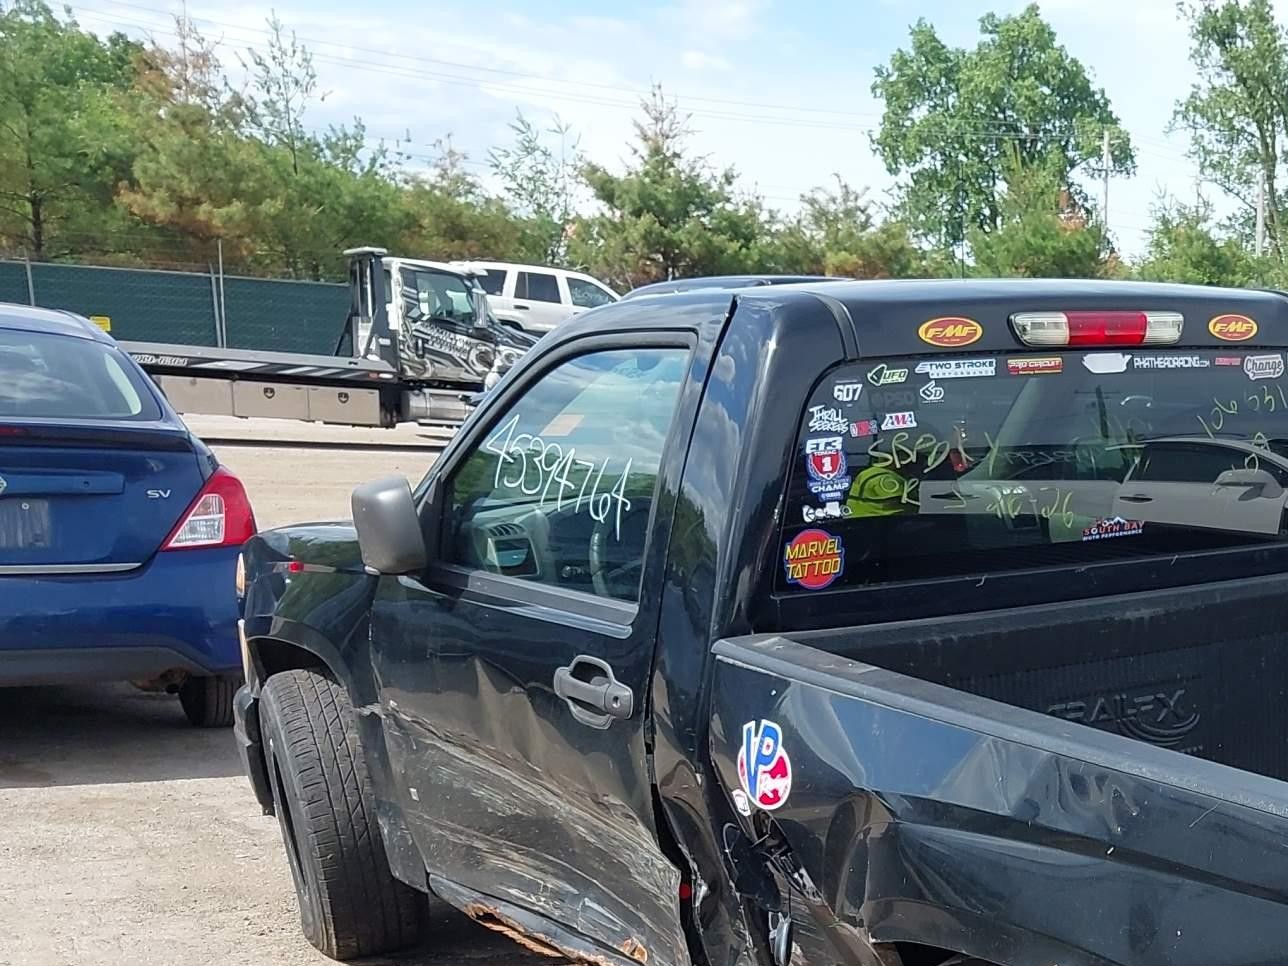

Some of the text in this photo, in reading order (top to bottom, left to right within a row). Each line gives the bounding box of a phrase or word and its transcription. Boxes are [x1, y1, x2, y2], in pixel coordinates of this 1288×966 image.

[926, 325, 977, 339] FMF
[1213, 321, 1253, 334] FMF
[929, 360, 994, 370] TWO STROKE
[1008, 360, 1062, 369] PRO CIRCUIT
[1245, 357, 1283, 376] Change
[883, 369, 906, 380] UFO
[833, 384, 863, 402] 607
[808, 404, 848, 423] THRILL
[884, 413, 916, 428] AMA
[808, 419, 849, 435] SEEKERS
[806, 436, 843, 454] ET3
[821, 456, 833, 472] 1
[486, 413, 633, 542] 45394764
[146, 489, 172, 498] SV
[811, 482, 849, 494] CHAMP
[1083, 520, 1145, 536] SOUTH BAY
[785, 537, 842, 561] MARVEL
[786, 557, 842, 580] TATTOO
